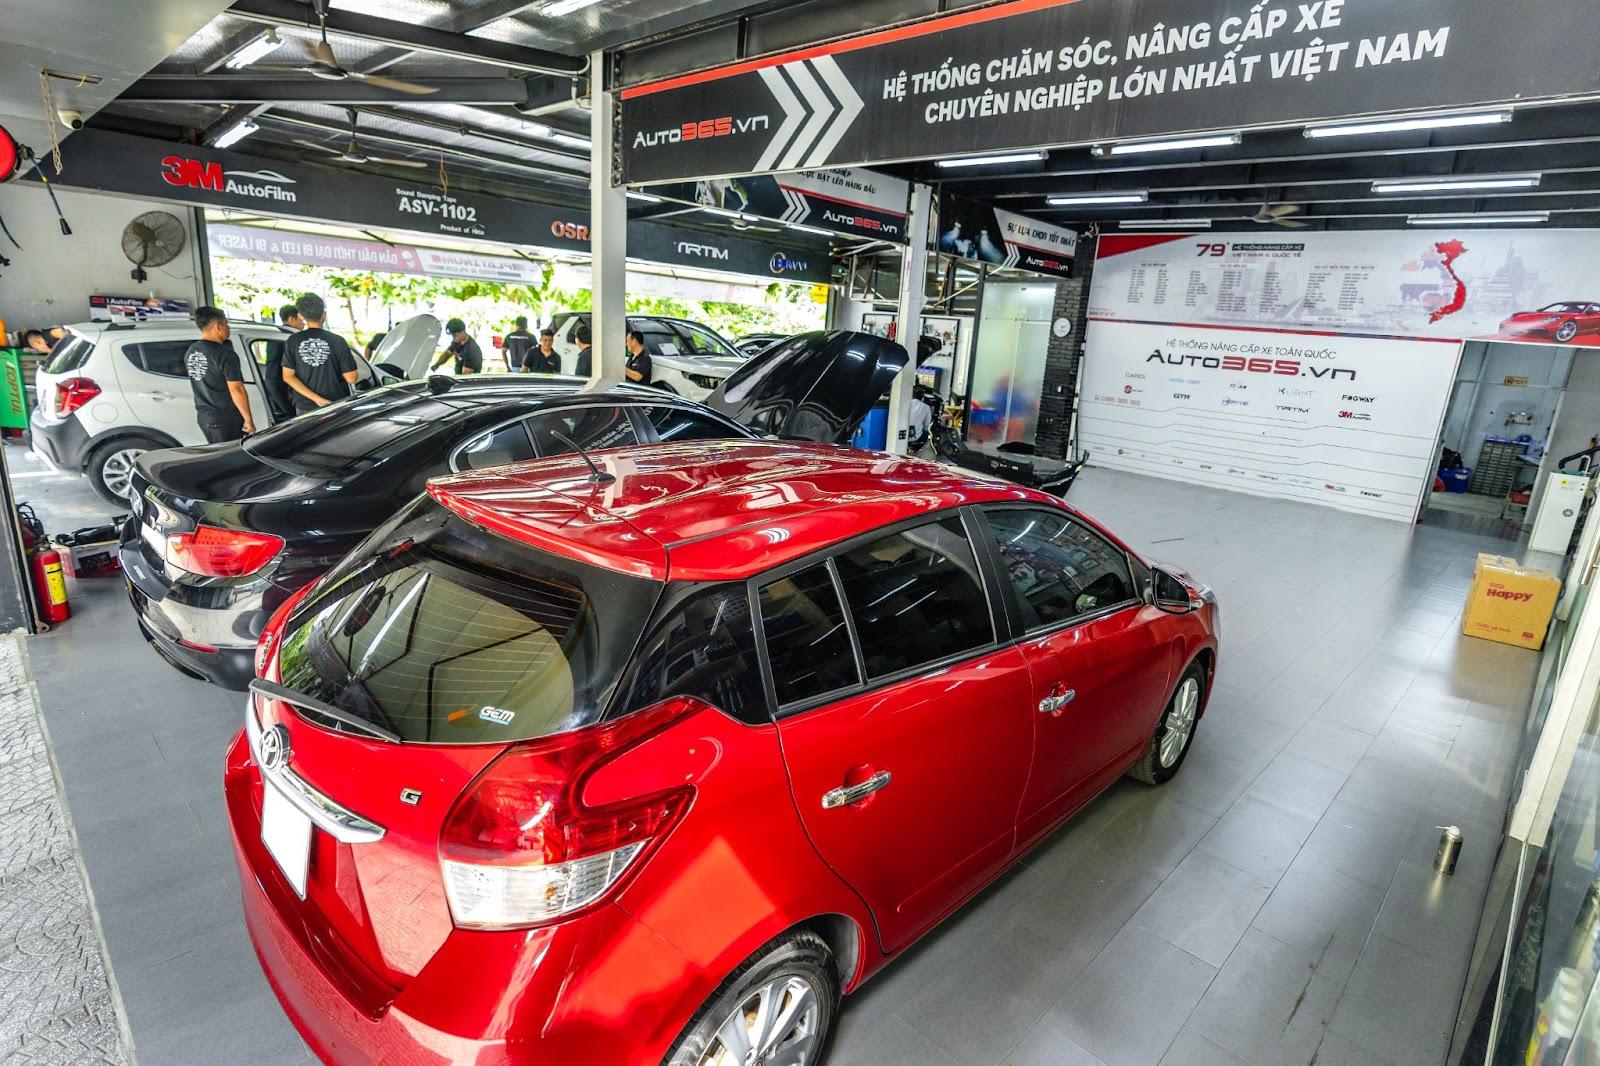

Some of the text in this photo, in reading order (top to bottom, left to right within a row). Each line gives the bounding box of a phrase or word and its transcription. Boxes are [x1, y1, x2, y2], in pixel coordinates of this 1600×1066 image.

[882, 0, 1345, 102] HỆ THỐNG CHĂM SÓC, NÂNG CẤP XE
[924, 26, 1451, 125] CHUYÊN NGHIỆP LỚN NHẤT VIỆT NAM
[161, 155, 224, 192] 3M
[225, 178, 297, 203] AutoFilm
[398, 196, 477, 222] ASV-1102
[1166, 338, 1337, 360] HỆ THỐNG NÂNG CẤP XE TOÀN QUỐC
[1338, 410, 1353, 419] 3M
[1486, 588, 1534, 602] Happy
